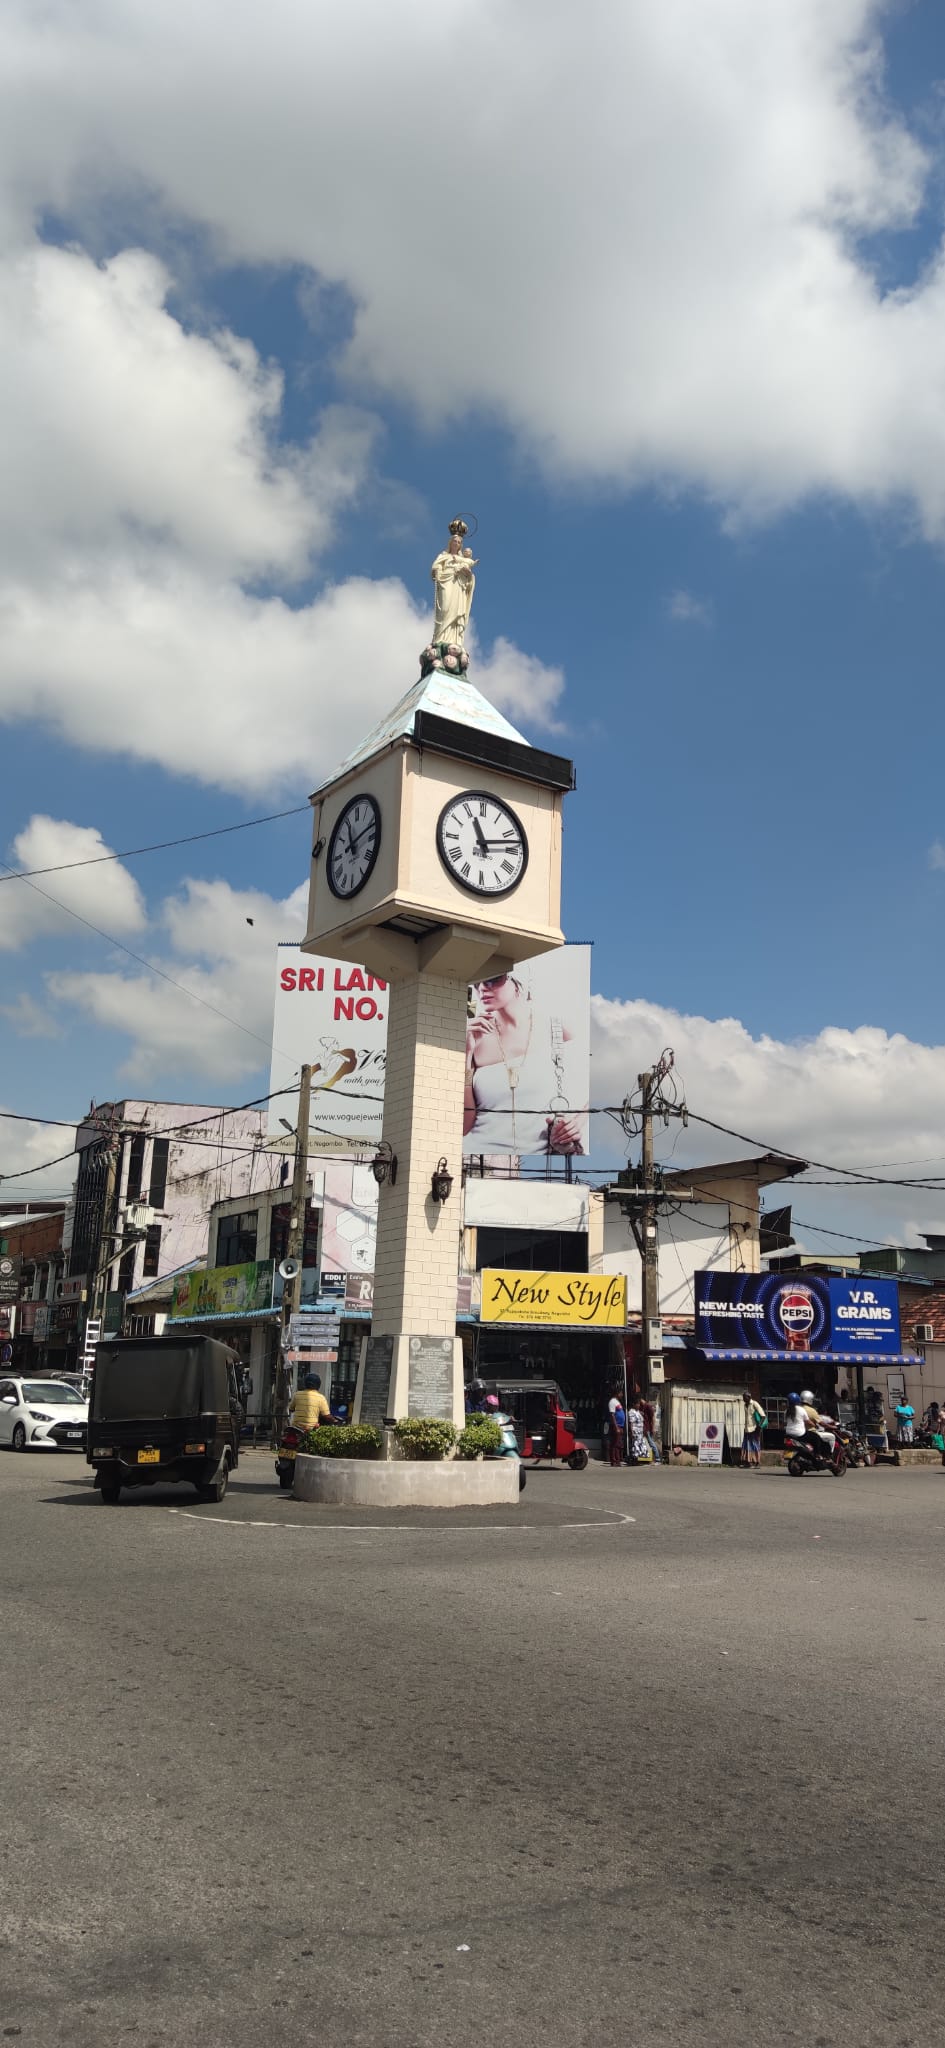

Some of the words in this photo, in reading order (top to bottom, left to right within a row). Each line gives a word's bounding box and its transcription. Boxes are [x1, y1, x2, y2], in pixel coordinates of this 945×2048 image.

[502, 829, 515, 838] II
[281, 967, 324, 991] SRI
[334, 996, 384, 1021] NO.
[491, 1277, 550, 1304] New
[848, 1291, 879, 1304] V.R.
[699, 1301, 728, 1311] NEW
[729, 1302, 764, 1312] LOOK
[782, 1308, 812, 1318] PEPSI
[837, 1306, 892, 1320] GRAMS
[699, 1310, 742, 1318] REFRESHING
